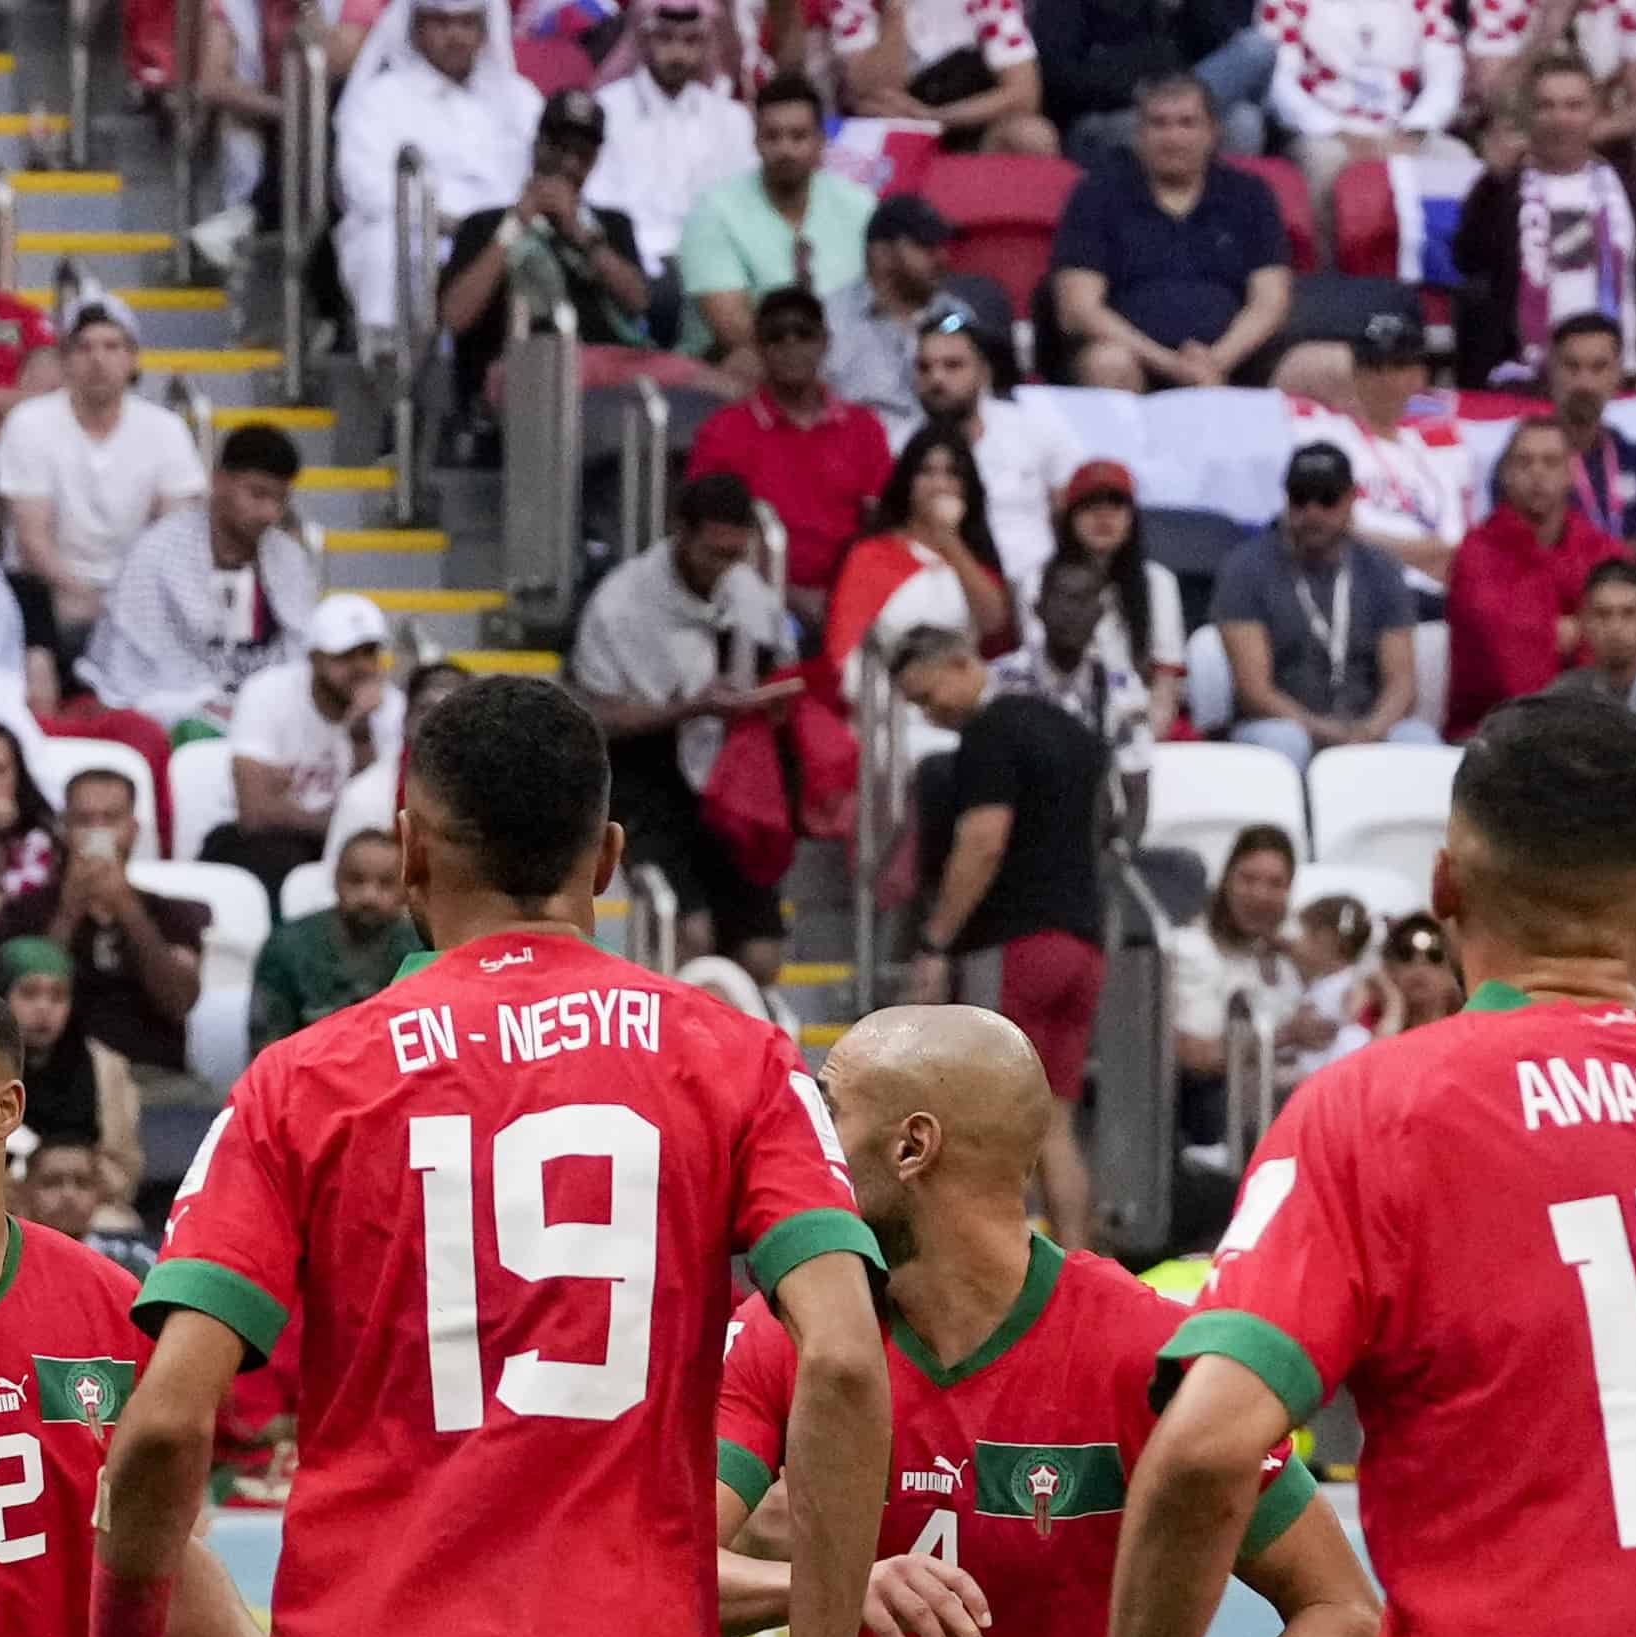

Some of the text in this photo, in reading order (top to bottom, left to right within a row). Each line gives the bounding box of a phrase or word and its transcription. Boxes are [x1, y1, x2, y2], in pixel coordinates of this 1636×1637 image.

[388, 1005, 458, 1074] EN
[498, 988, 660, 1063] NESYRI
[409, 1103, 661, 1433] 19
[901, 1471, 954, 1495] PUMA
